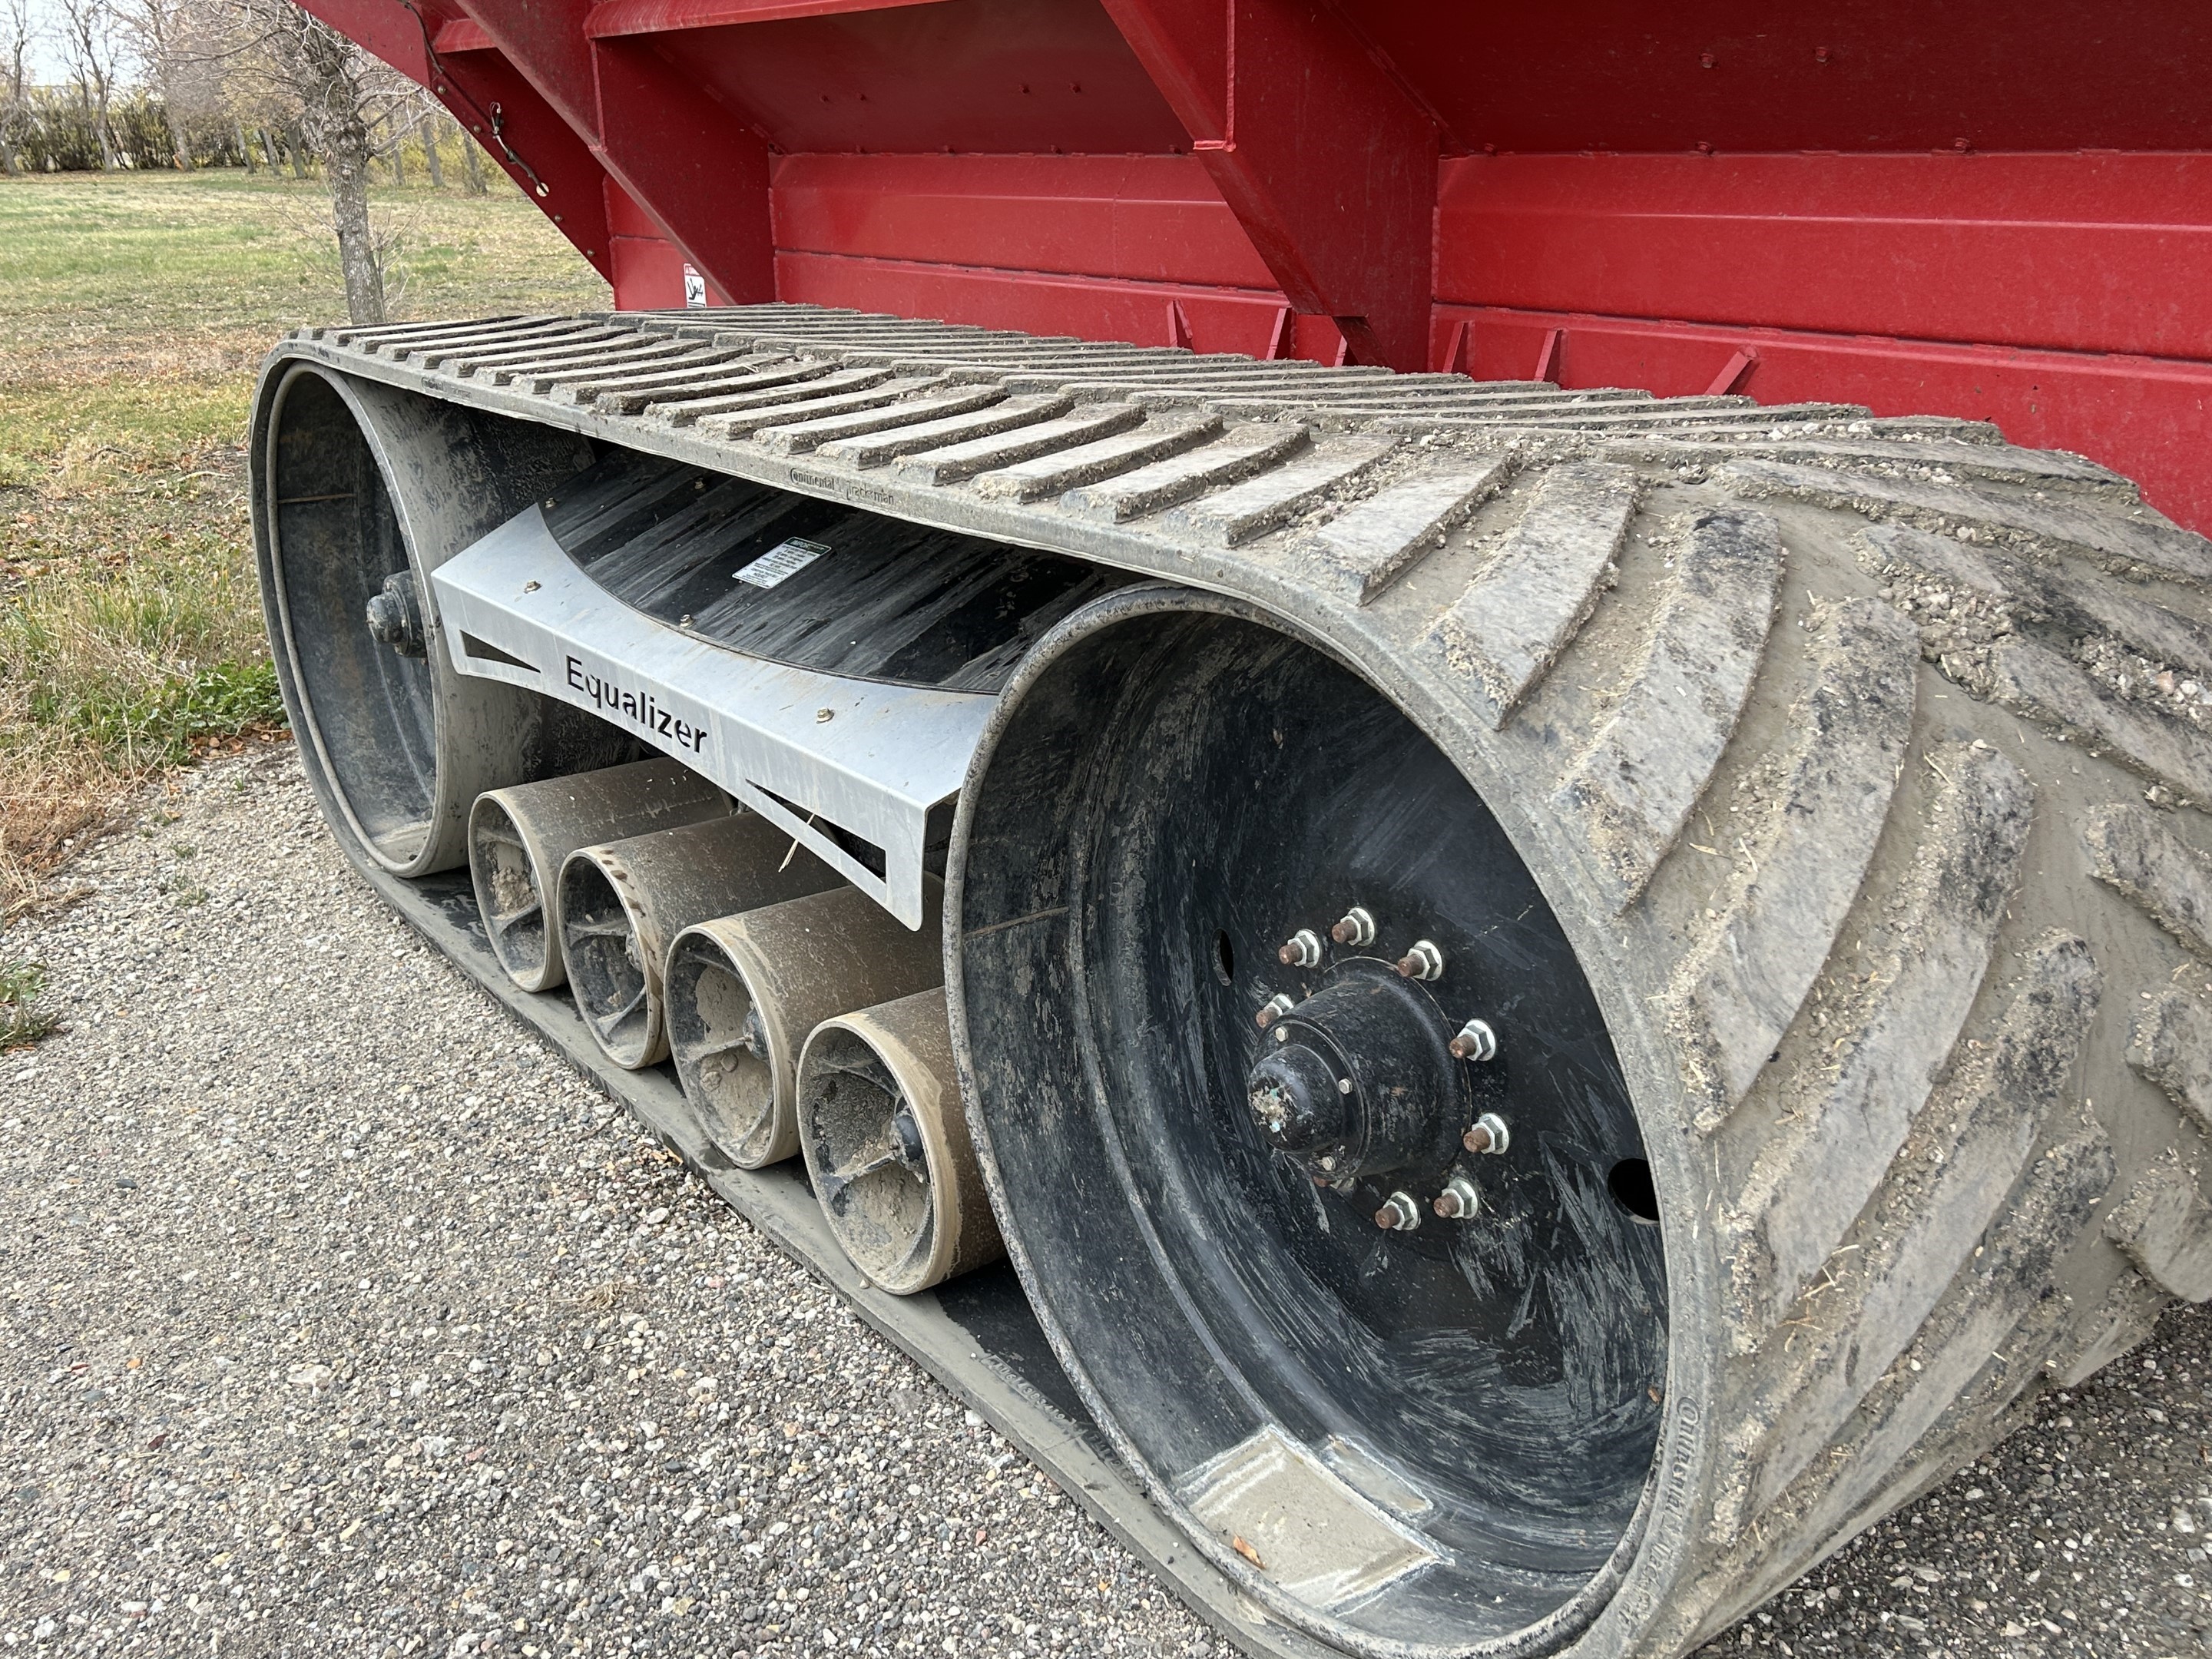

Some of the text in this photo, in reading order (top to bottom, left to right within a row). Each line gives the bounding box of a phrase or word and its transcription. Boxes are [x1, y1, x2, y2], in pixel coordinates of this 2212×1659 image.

[790, 467, 896, 505] Continental Trackman
[565, 654, 708, 754] Equalizer
[1664, 1396, 1701, 1518] Continental
